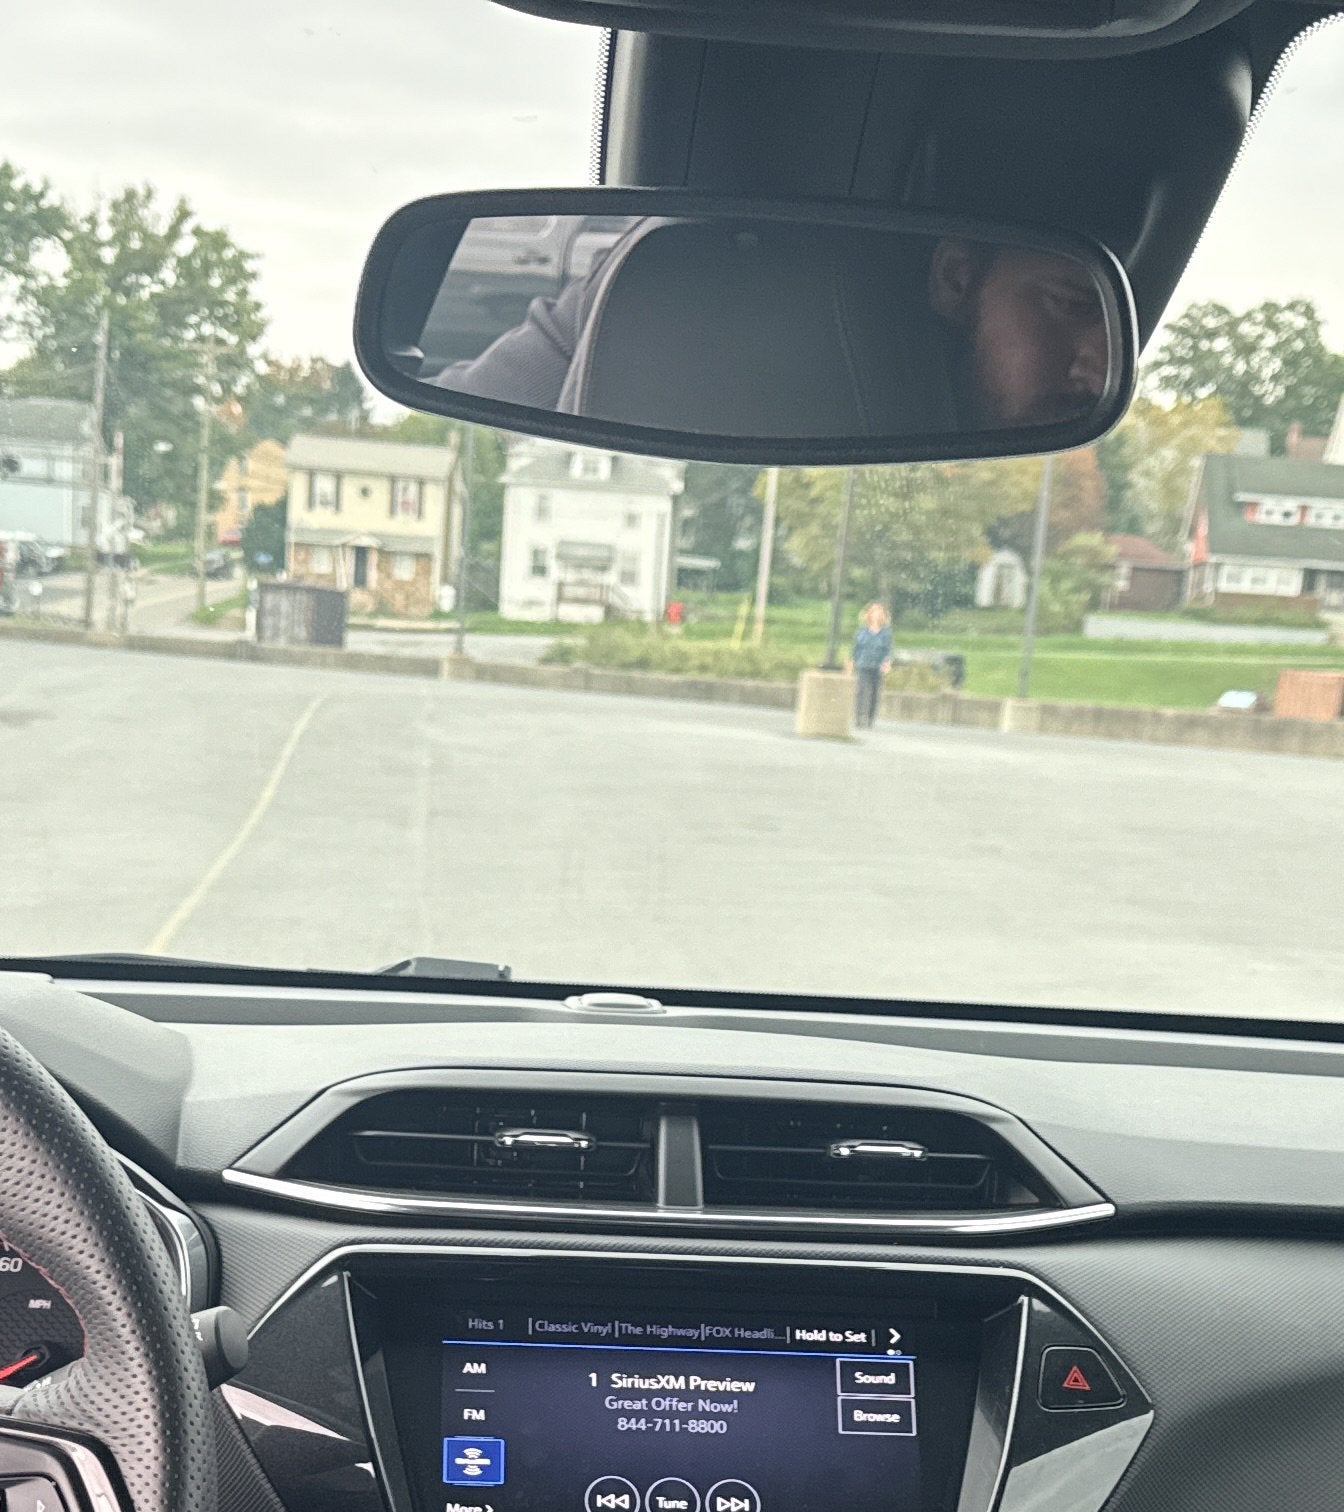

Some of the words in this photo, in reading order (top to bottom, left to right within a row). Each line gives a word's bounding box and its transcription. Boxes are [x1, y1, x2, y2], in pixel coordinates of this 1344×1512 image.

[28, 1299, 52, 1310] MPH
[468, 1318, 495, 1331] Hits
[498, 1319, 504, 1331] 1
[535, 1320, 579, 1334] Classic
[581, 1322, 613, 1337] Vinyl
[619, 1323, 643, 1336] The
[646, 1325, 700, 1340] Highway
[705, 1326, 732, 1339] FOX
[795, 1329, 826, 1342] Hold
[828, 1331, 843, 1342] to
[845, 1332, 867, 1343] Set
[462, 1362, 487, 1374] AM
[588, 1372, 598, 1387] 1
[611, 1373, 686, 1390] SiriusXM
[689, 1376, 755, 1393] Preview
[855, 1372, 896, 1385] Sound
[605, 1396, 648, 1411] Great
[651, 1396, 693, 1412] Offer
[698, 1398, 739, 1413] Now!
[463, 1408, 485, 1421] FM
[853, 1409, 901, 1423] Browse
[617, 1417, 727, 1434] 844-711-8800
[656, 1496, 688, 1509] Tune
